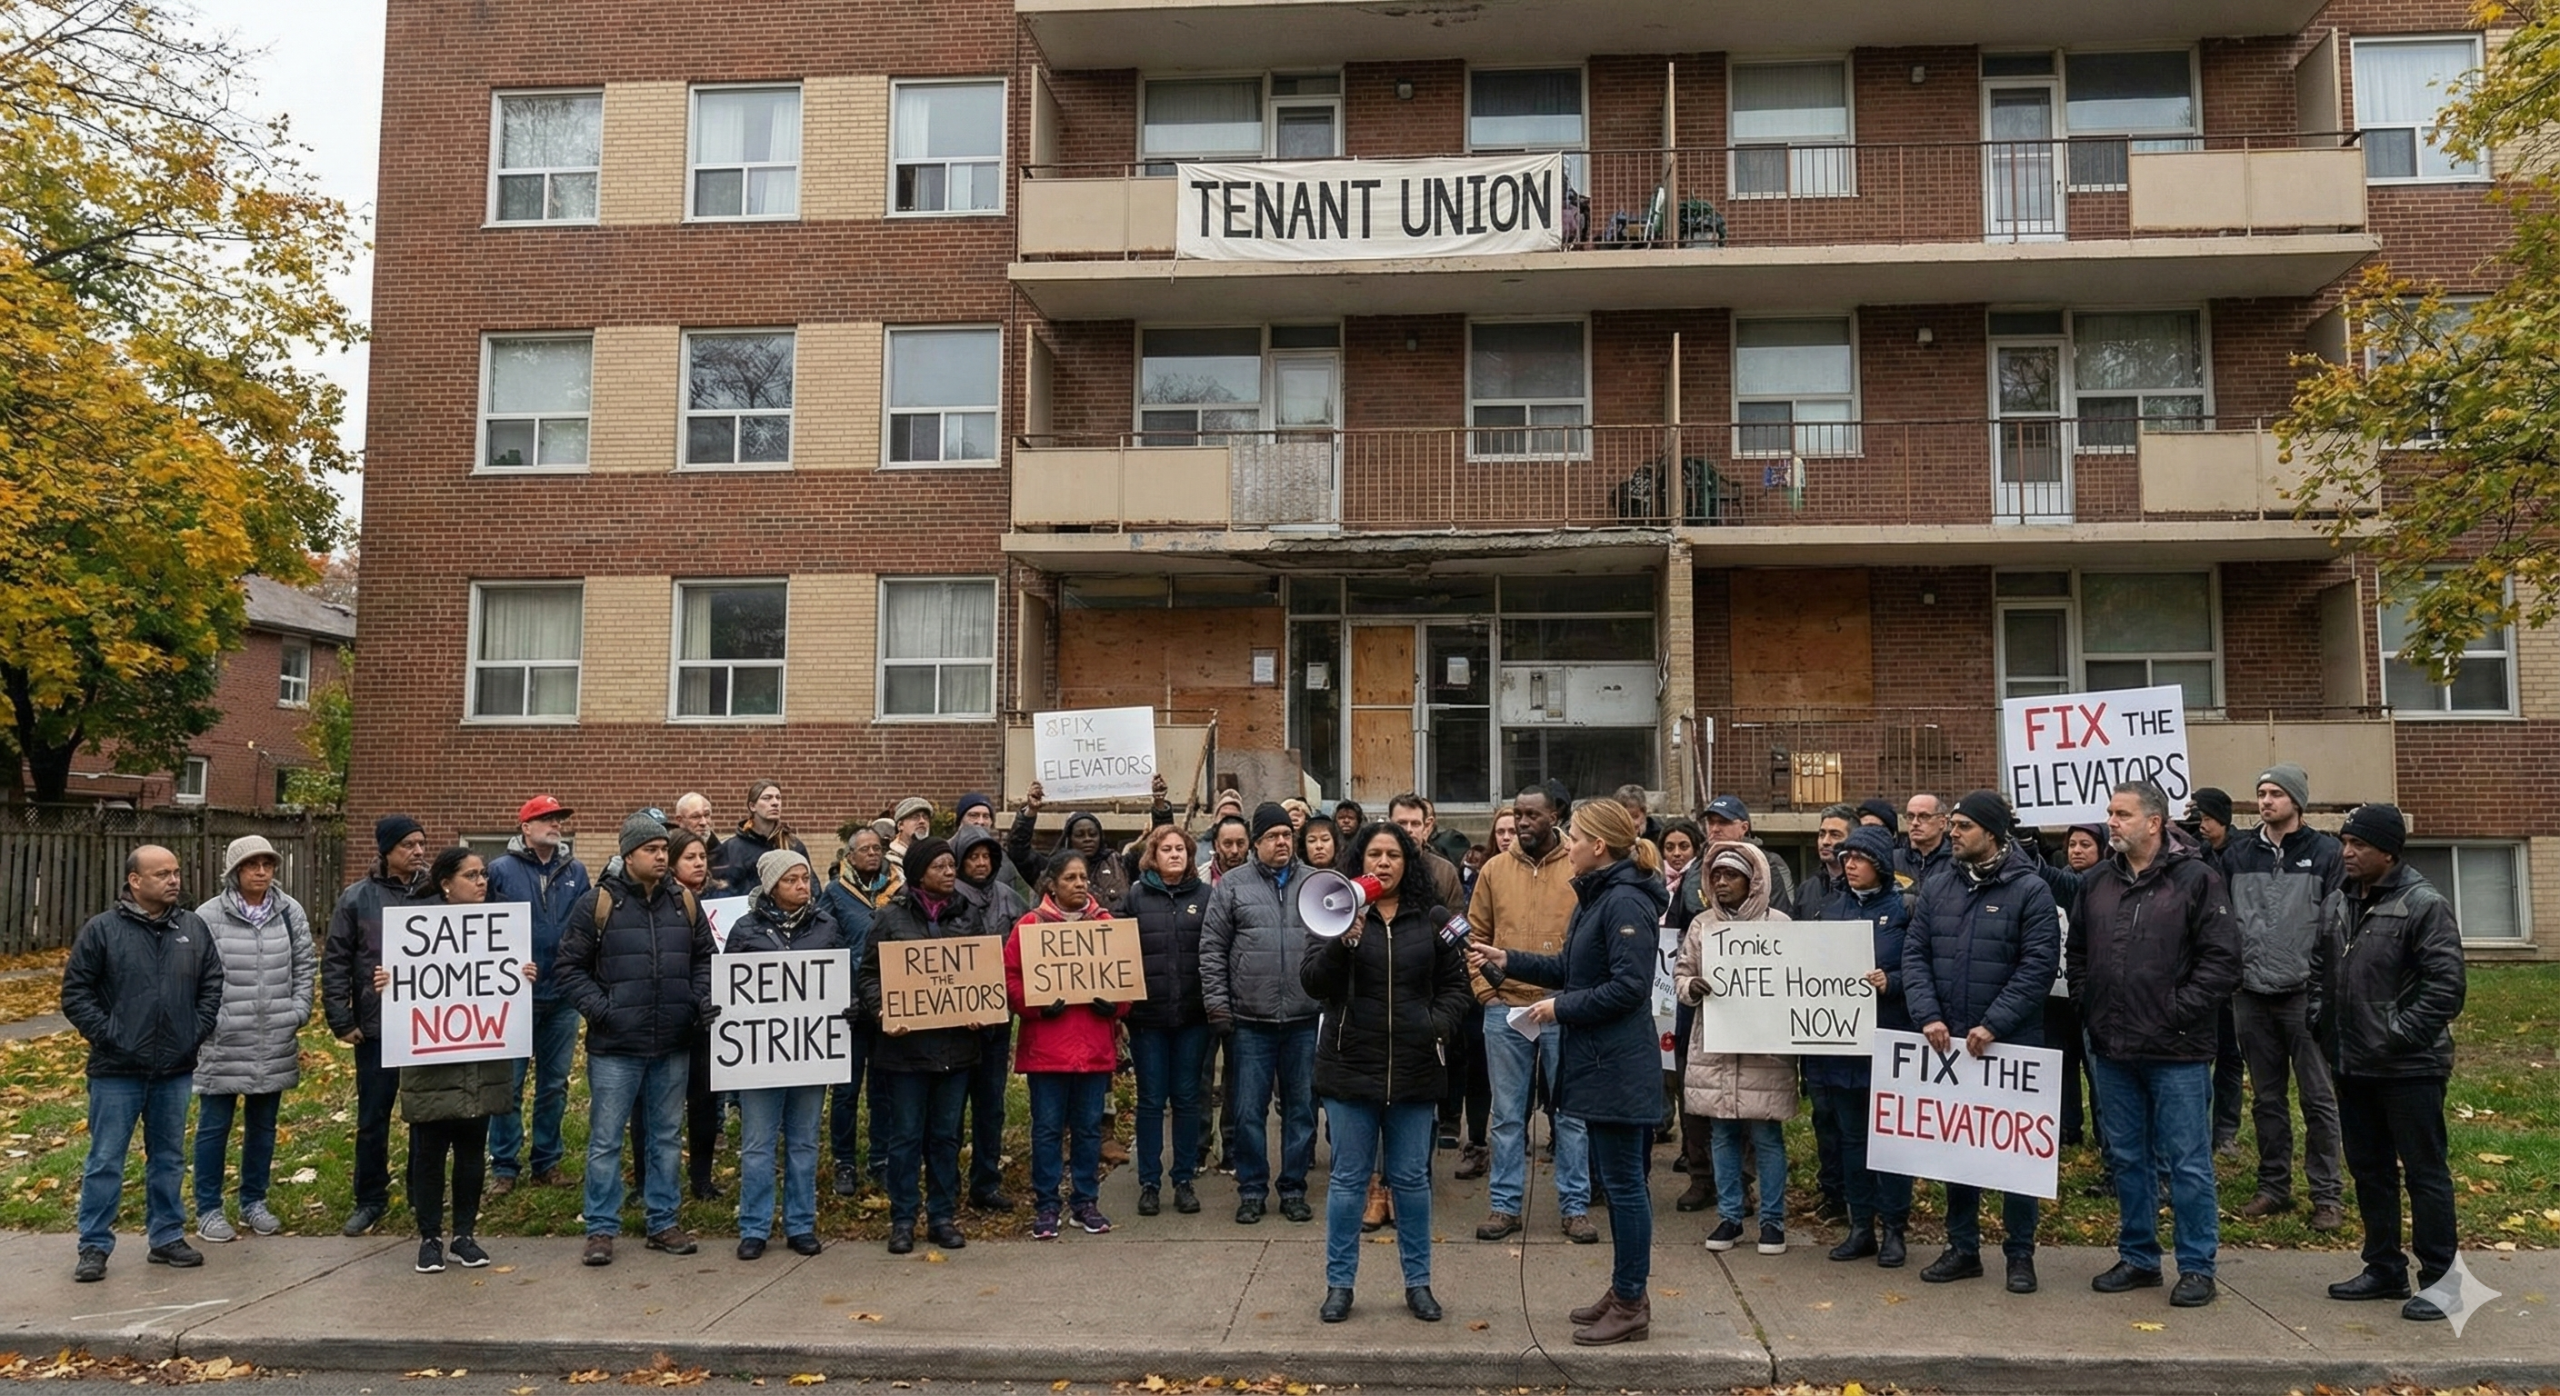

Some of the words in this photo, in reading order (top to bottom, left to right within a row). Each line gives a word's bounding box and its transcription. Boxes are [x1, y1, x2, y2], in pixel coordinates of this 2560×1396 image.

[1191, 179, 1381, 240] TENANT
[1401, 169, 1552, 237] UNION
[1073, 738, 1107, 753] THE
[2025, 702, 2110, 751] FIX
[2121, 709, 2175, 736] THE
[1043, 755, 1153, 781] ELEVATORS
[401, 912, 510, 957] SAFE
[1041, 924, 1113, 957] RENT
[393, 957, 521, 1002] HOMES
[904, 943, 980, 976] RENT
[1034, 960, 1135, 992] STRIKE
[730, 959, 835, 1006] RENT
[930, 974, 955, 986] THE
[1712, 966, 1775, 997] SAFE
[1786, 966, 1873, 997] Homes
[887, 983, 1006, 1018] ELEVATORS
[411, 1001, 510, 1046] NOW
[716, 1014, 847, 1067] STRIKE
[1790, 1007, 1861, 1038] NOW
[1892, 1041, 1961, 1086] FIX
[1976, 1055, 2041, 1093] THE
[1875, 1092, 2055, 1158] ELEVATORS
